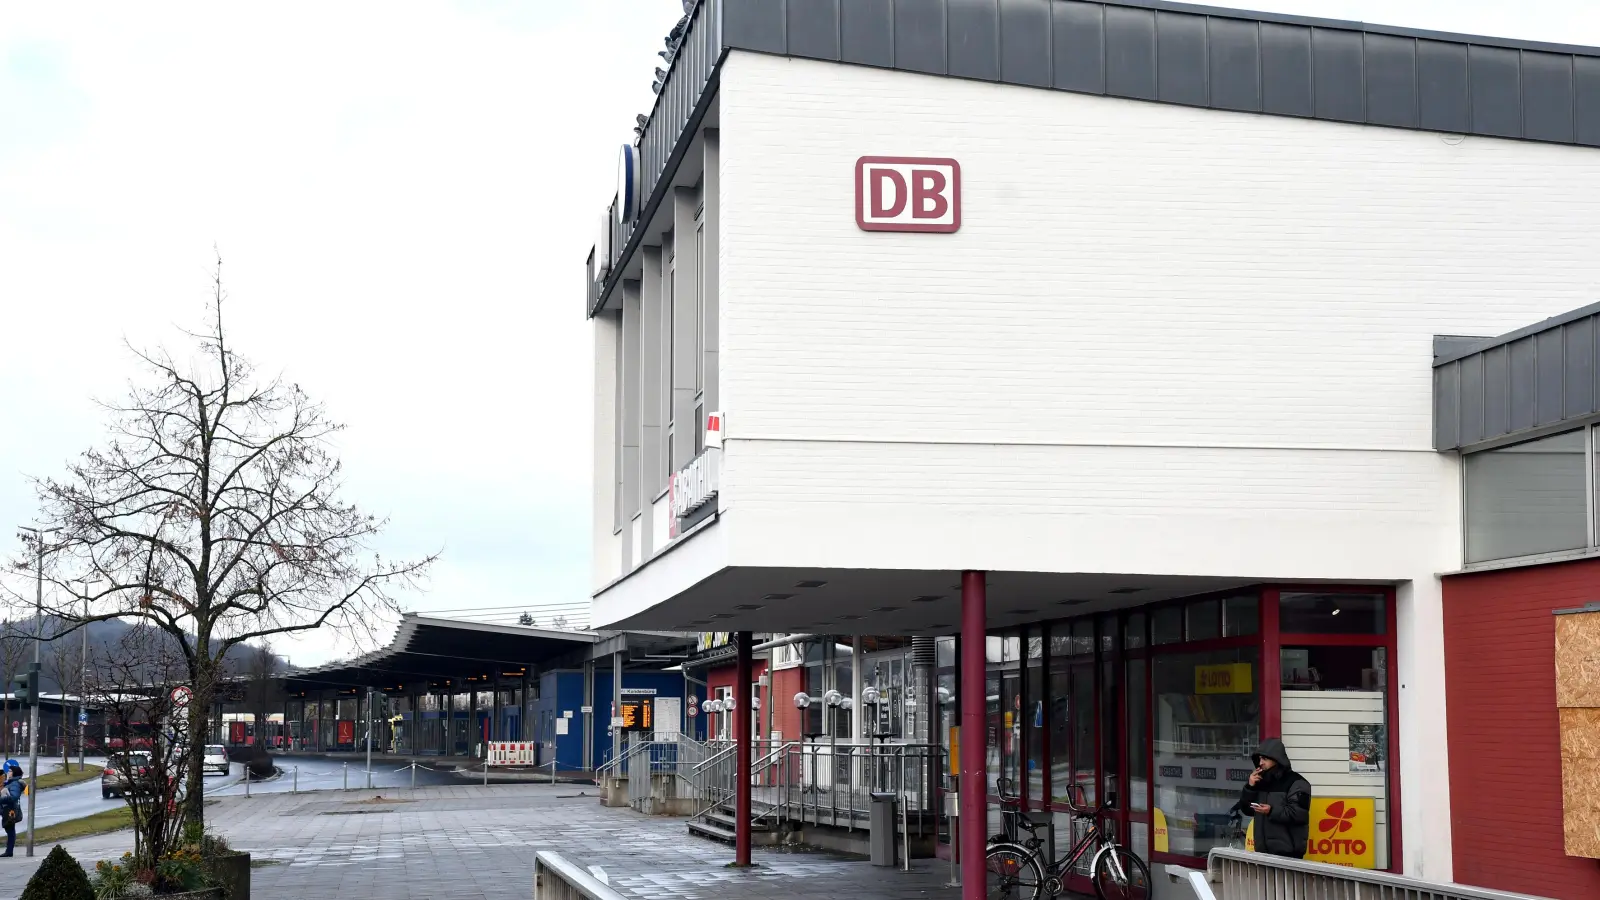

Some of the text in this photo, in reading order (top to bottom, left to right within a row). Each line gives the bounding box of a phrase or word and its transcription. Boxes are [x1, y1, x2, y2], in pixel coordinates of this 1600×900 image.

[870, 168, 948, 219] DB
[1208, 670, 1231, 688] LOTTO
[1308, 839, 1367, 855] LOTTO
